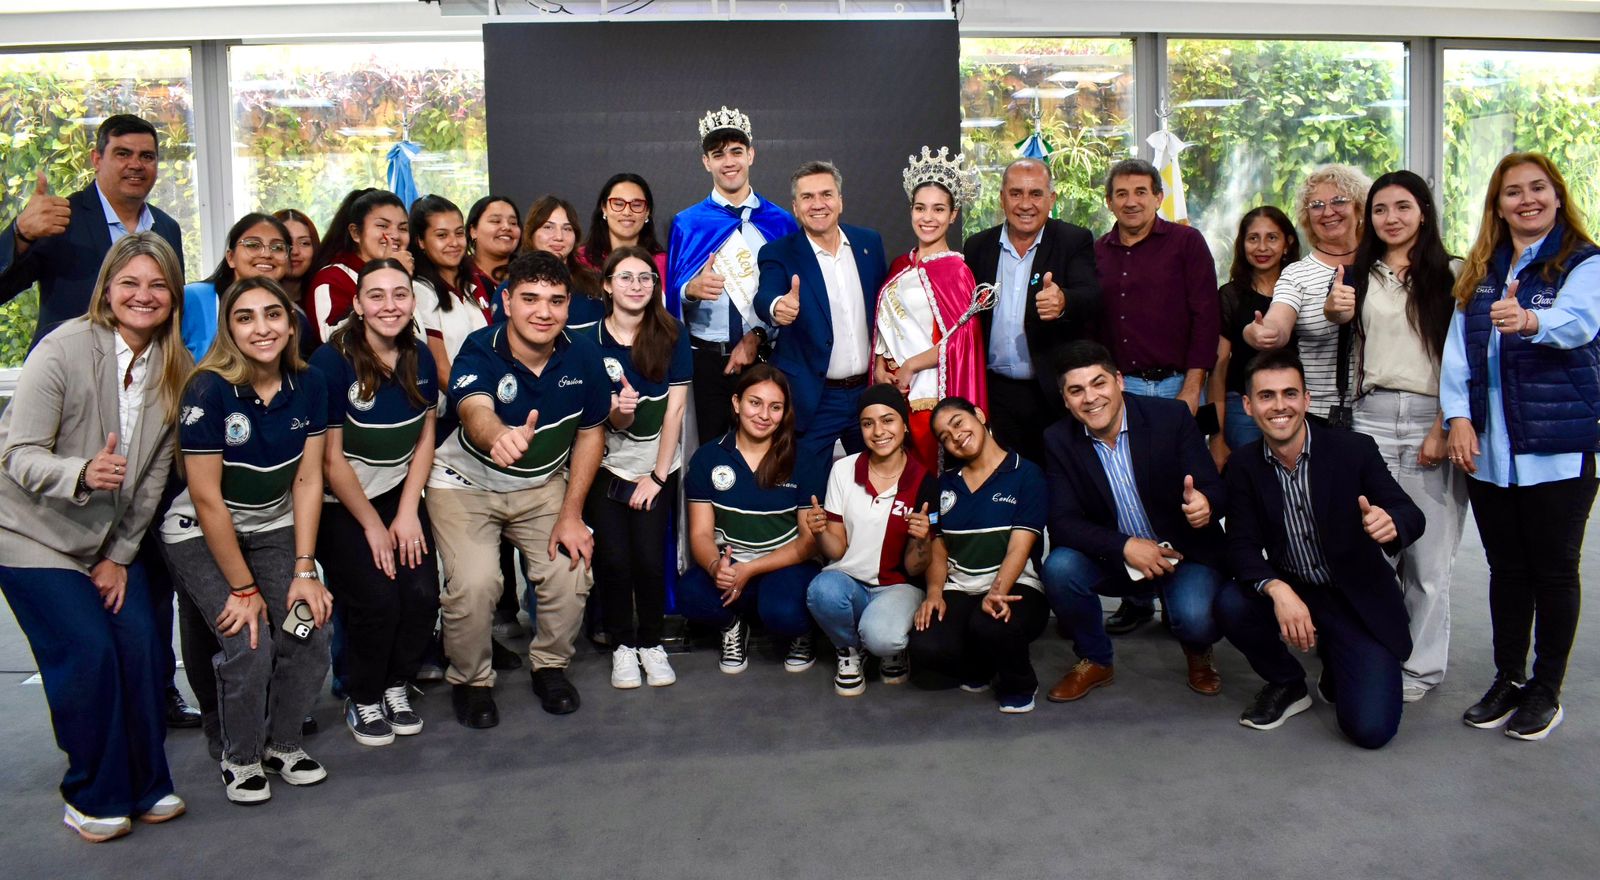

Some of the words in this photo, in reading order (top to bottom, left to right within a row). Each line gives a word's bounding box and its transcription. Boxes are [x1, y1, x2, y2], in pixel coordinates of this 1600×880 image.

[735, 247, 755, 278] Rey
[1531, 293, 1555, 305] Chac
[558, 375, 583, 388] Gaston
